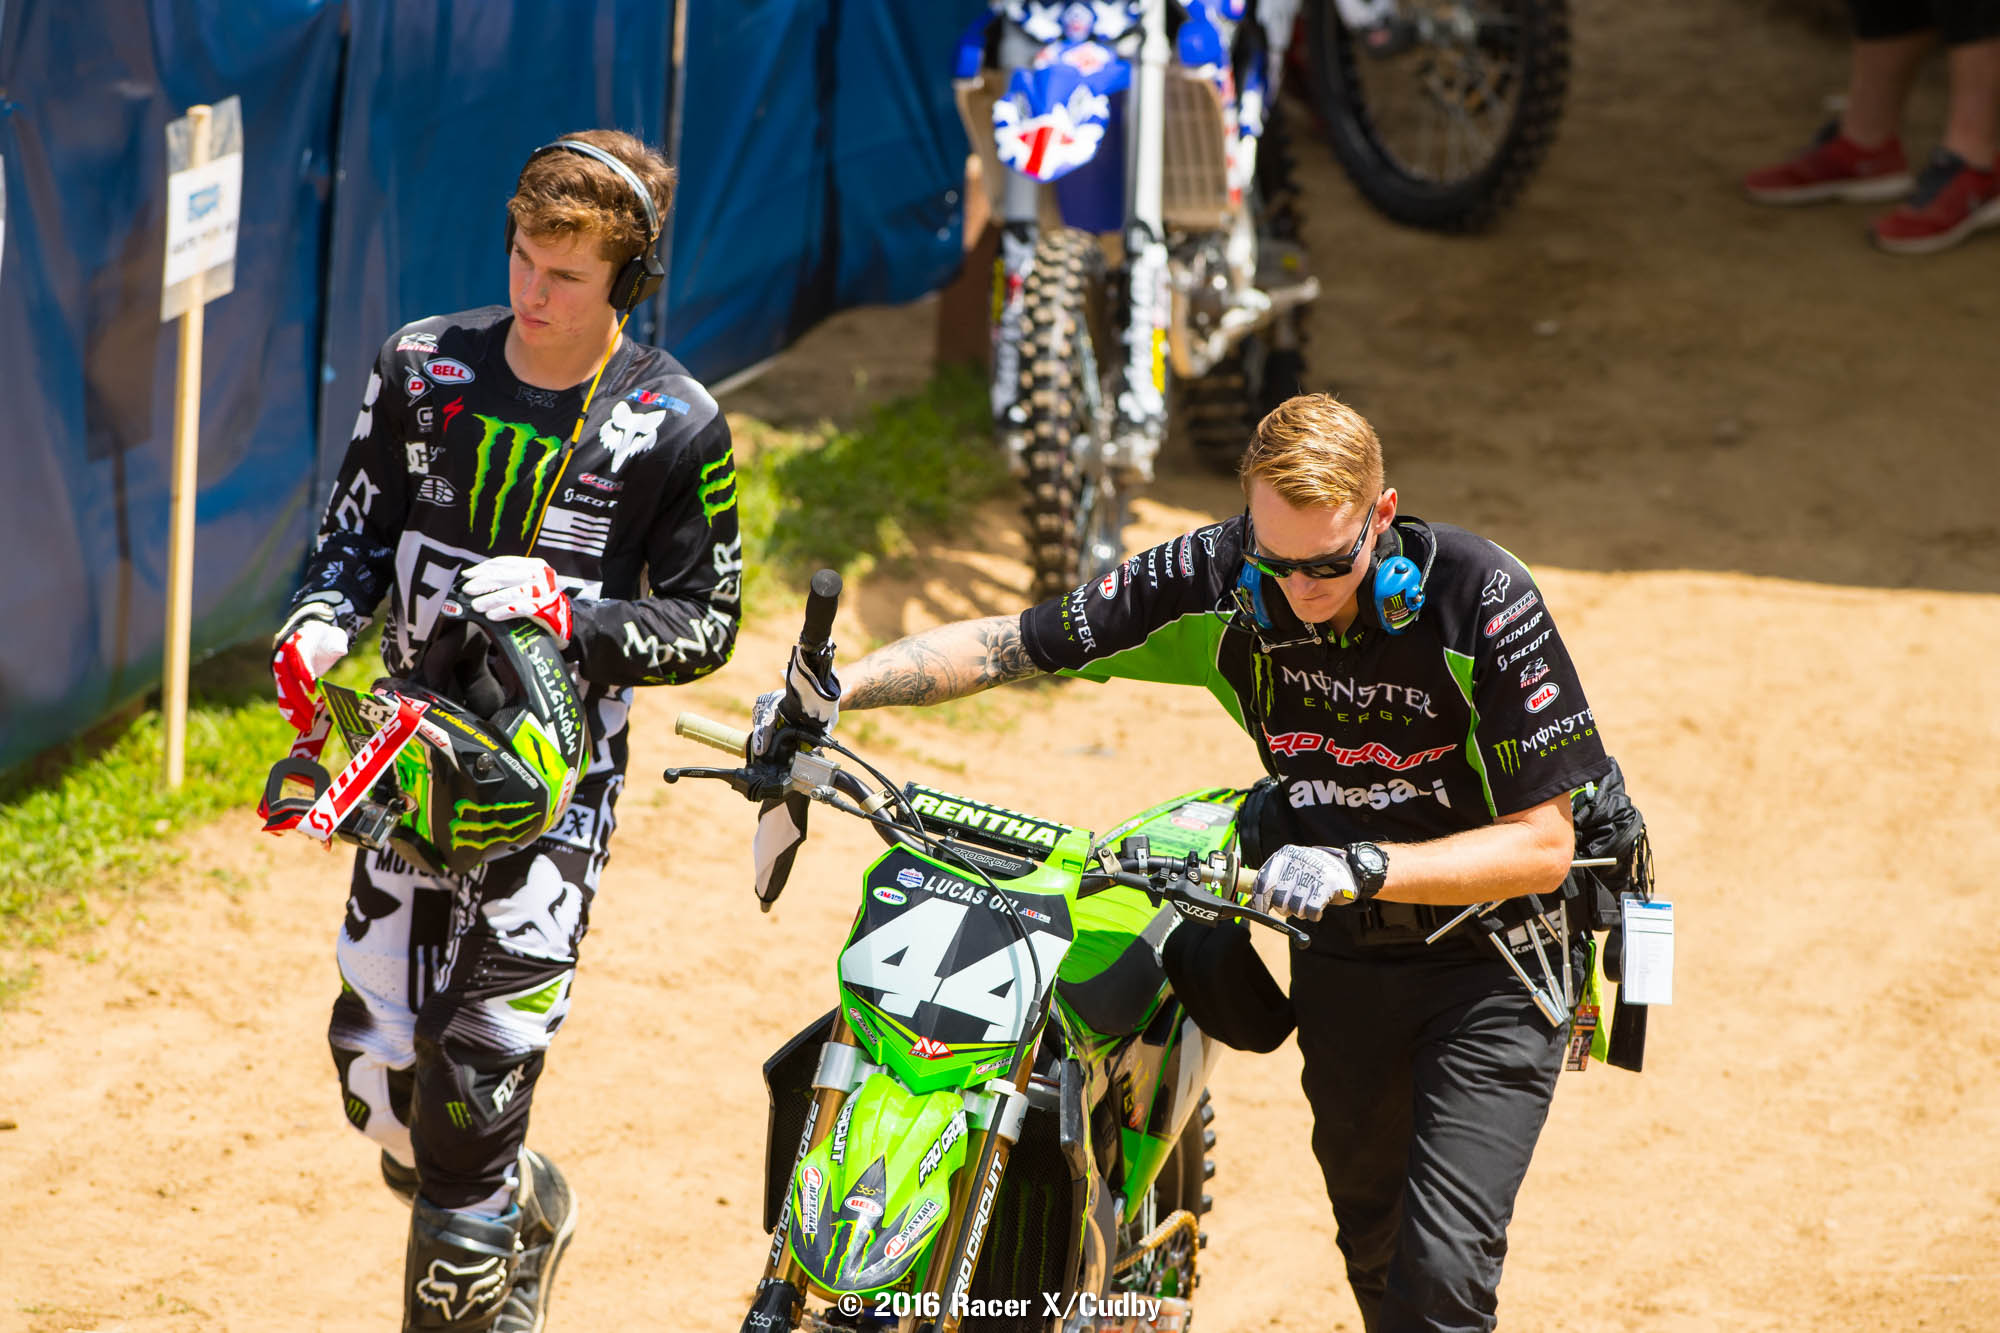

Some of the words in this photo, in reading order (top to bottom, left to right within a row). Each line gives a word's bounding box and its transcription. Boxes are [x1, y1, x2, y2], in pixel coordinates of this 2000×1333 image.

[432, 365, 466, 379] BELL
[1496, 611, 1543, 650] DUNLOP
[1509, 629, 1553, 664] SCOTT
[1280, 665, 1439, 719] MONSTER
[1531, 688, 1554, 709] BELL
[1303, 697, 1413, 727] ENERGY
[1521, 707, 1594, 753] MONSTE
[328, 717, 402, 803] SCOTT
[1539, 725, 1599, 758] ENERG
[1281, 775, 1452, 811] awasai
[910, 792, 1069, 849] RENTHA
[923, 875, 988, 905] LUCAS
[1174, 899, 1219, 921] ARC
[841, 896, 1073, 1042] 44
[491, 1063, 525, 1114] FOX
[917, 1139, 943, 1189] PRO
[966, 1152, 1004, 1260] CIRCUIT
[749, 1311, 772, 1328] 360
